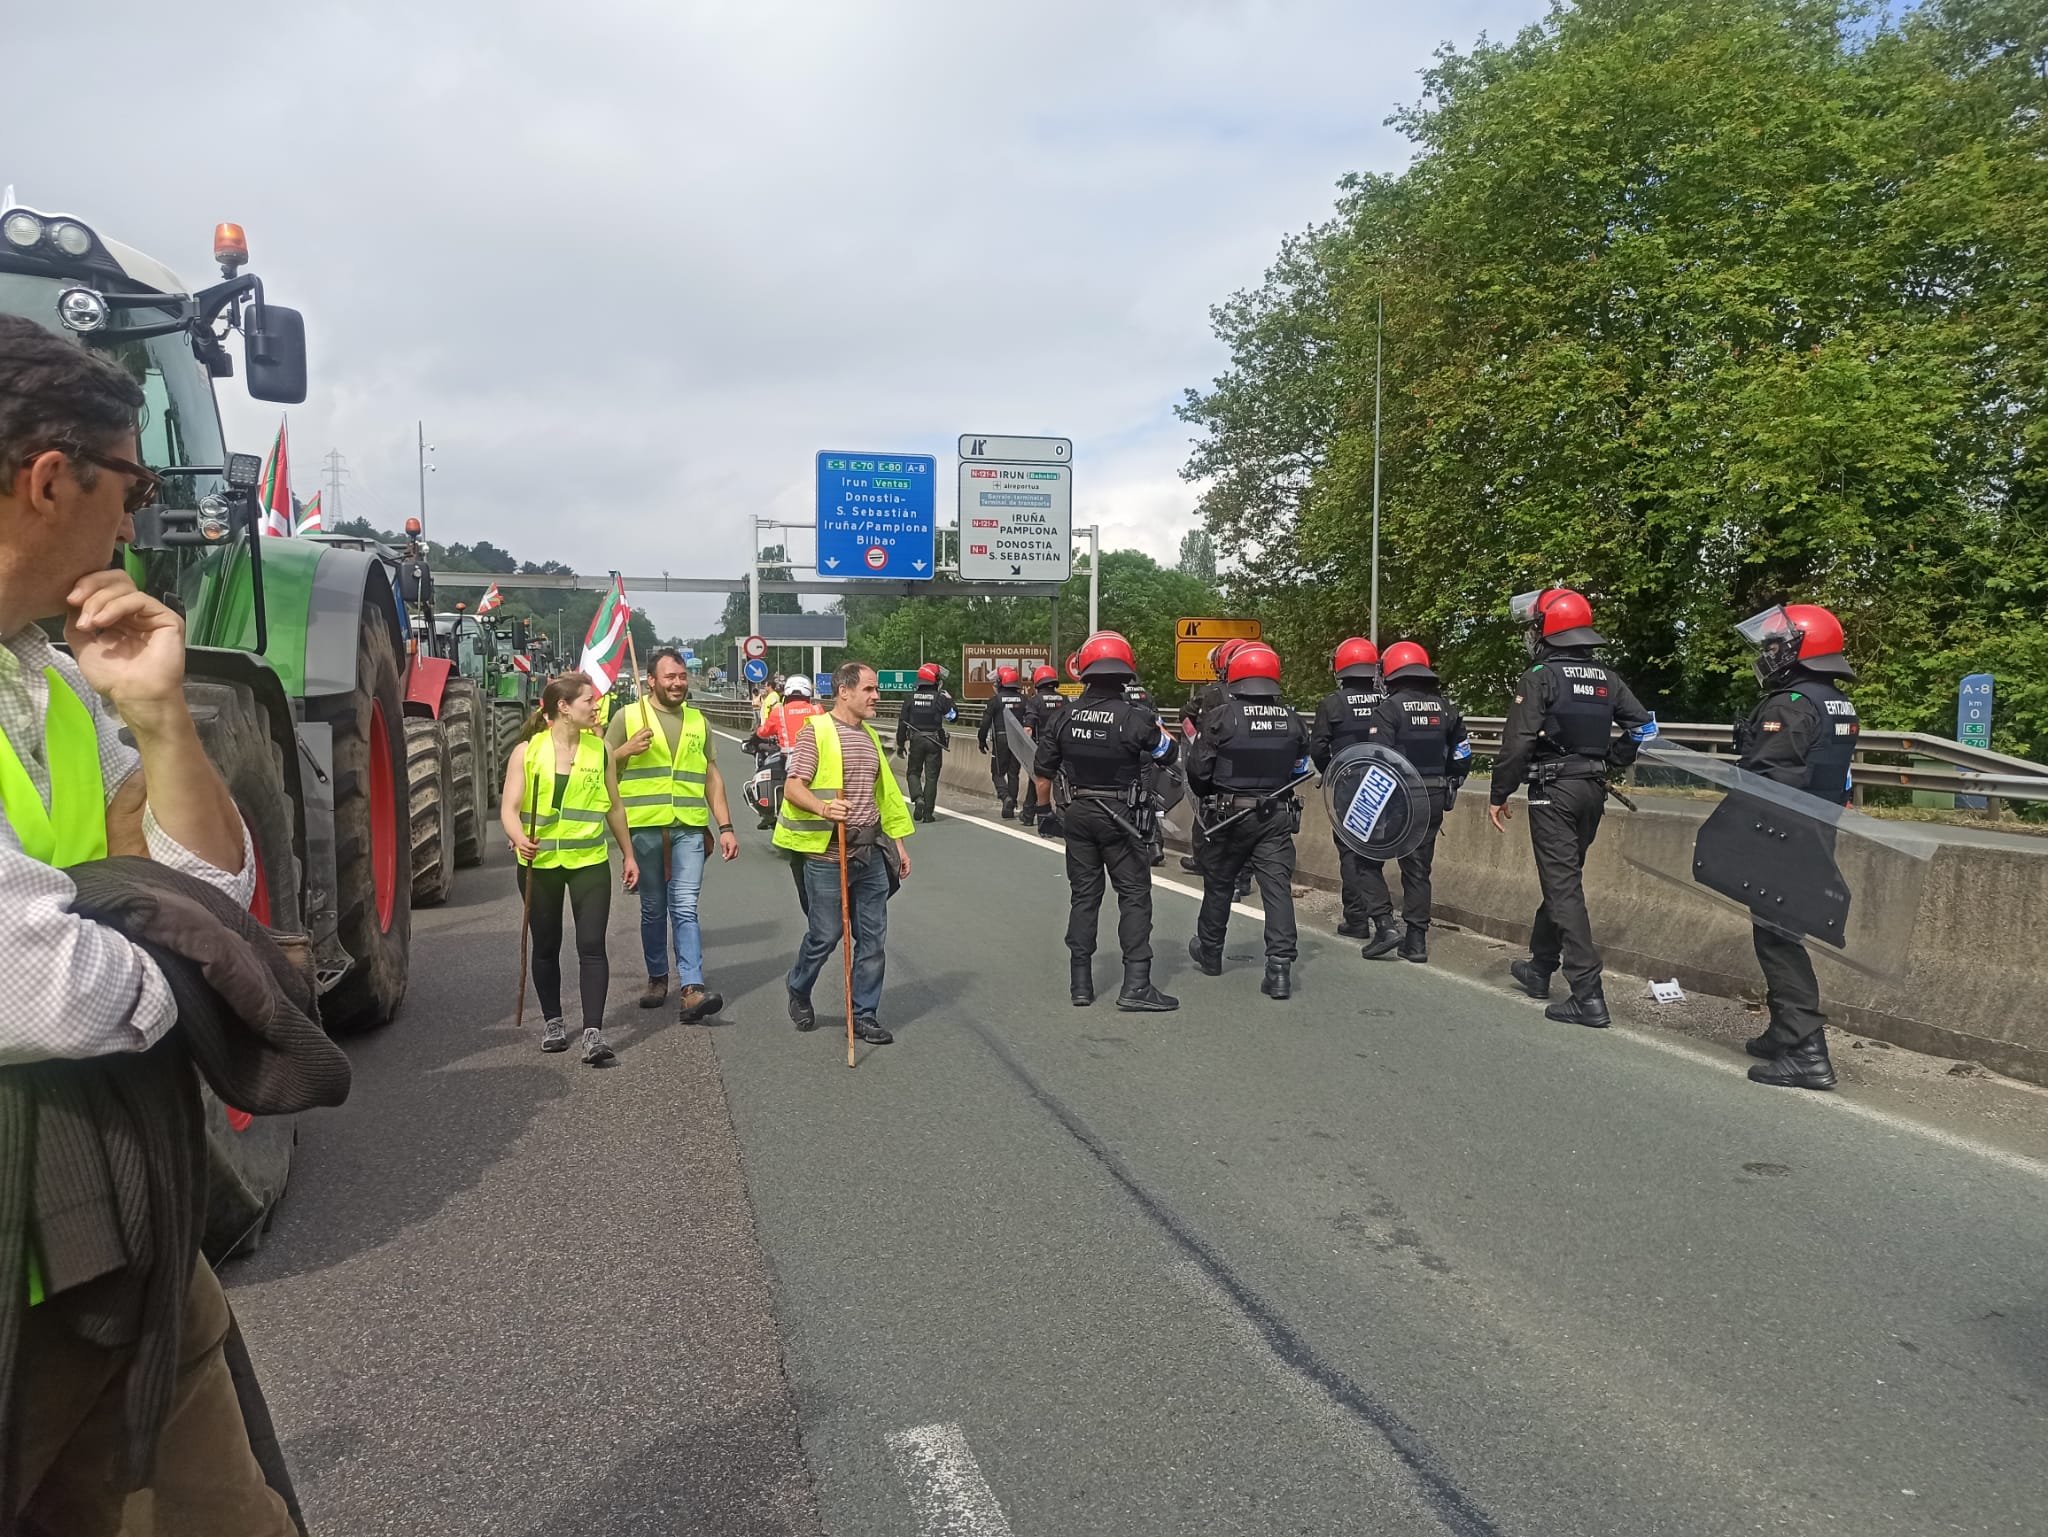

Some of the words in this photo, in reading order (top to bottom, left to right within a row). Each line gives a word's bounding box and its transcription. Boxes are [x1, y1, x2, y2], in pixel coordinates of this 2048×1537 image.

[1055, 445, 1064, 456] 0
[827, 460, 845, 469] E-5
[850, 461, 874, 470] E-70
[879, 462, 901, 472] E-80
[907, 464, 925, 473] A-8
[971, 470, 997, 478] N-121-A
[999, 470, 1025, 480] IRUN
[841, 476, 868, 487] Irun
[875, 479, 908, 488] Ventas
[845, 491, 906, 503] Donostia-
[836, 505, 847, 516] S.
[852, 506, 917, 518] Sebastián
[1012, 512, 1046, 523] IRUÑA
[824, 520, 928, 533] Iruña/Pamplona
[973, 520, 998, 528] N-121-A
[1000, 526, 1058, 535] PAMPLONA
[856, 535, 896, 546] Bilbao
[996, 540, 1053, 549] DONOSTIA
[989, 552, 998, 560] S.
[1000, 552, 1061, 561] SEBASTIÁN
[1562, 666, 1608, 681] ERTZAINTZA
[1573, 684, 1595, 696] M4S9
[1962, 684, 1990, 695] A-8
[1243, 704, 1289, 717] ERTZAINTZA
[1402, 700, 1442, 712] ERTZAINTZA
[1970, 708, 1980, 719] 0
[1250, 720, 1273, 731] A2N6
[1965, 724, 1983, 733] E-5
[1071, 727, 1092, 739] V7L6
[1345, 769, 1394, 837] ERTZAINTZA
